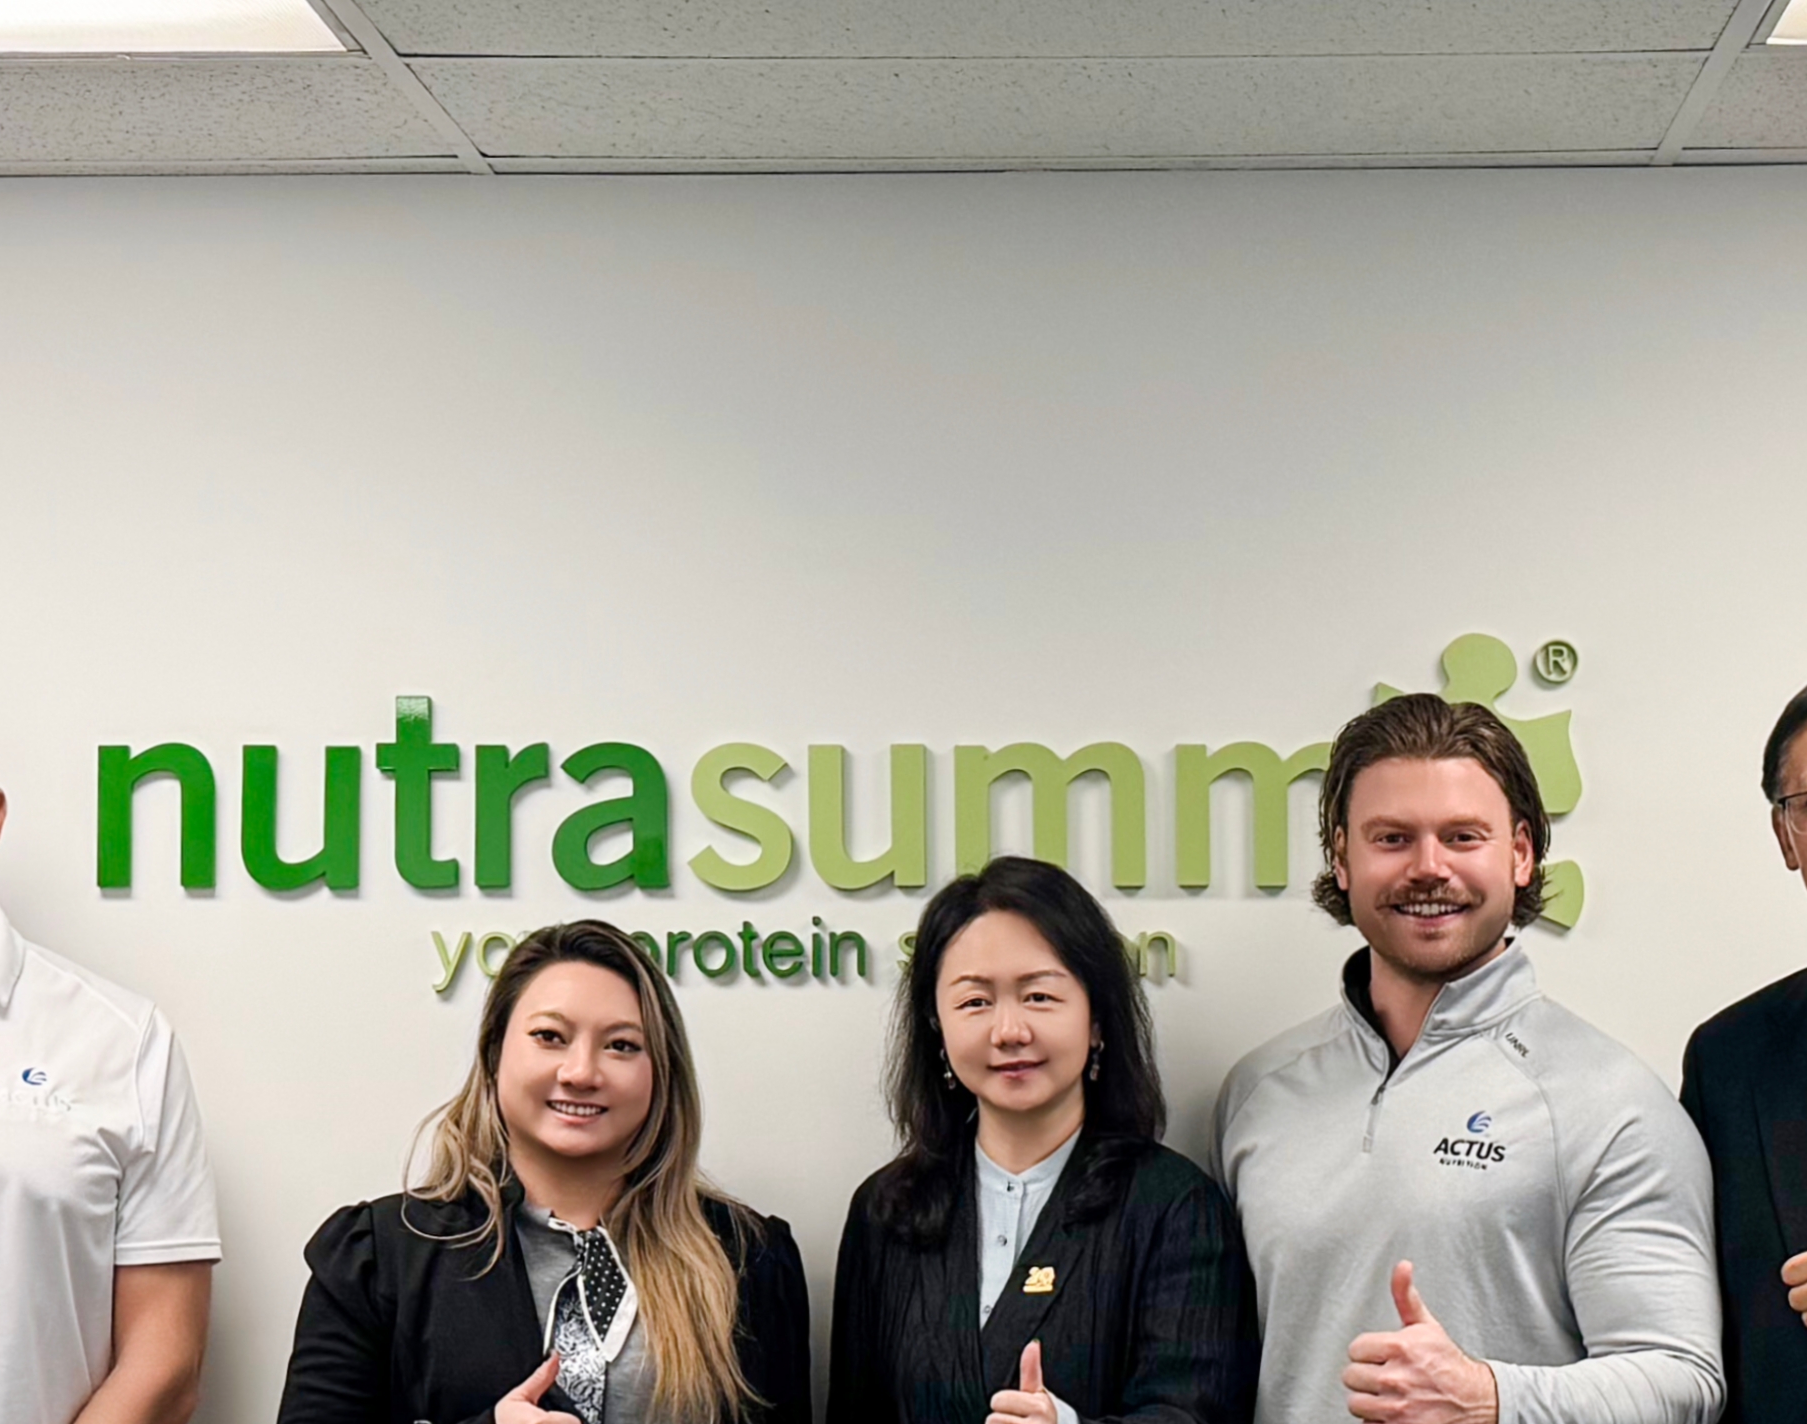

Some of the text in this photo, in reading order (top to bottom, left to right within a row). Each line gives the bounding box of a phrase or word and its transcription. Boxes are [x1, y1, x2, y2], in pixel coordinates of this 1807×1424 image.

[97, 696, 1333, 892] nutrasumm
[430, 930, 513, 994] yo
[1433, 1137, 1506, 1162] ACTUS
